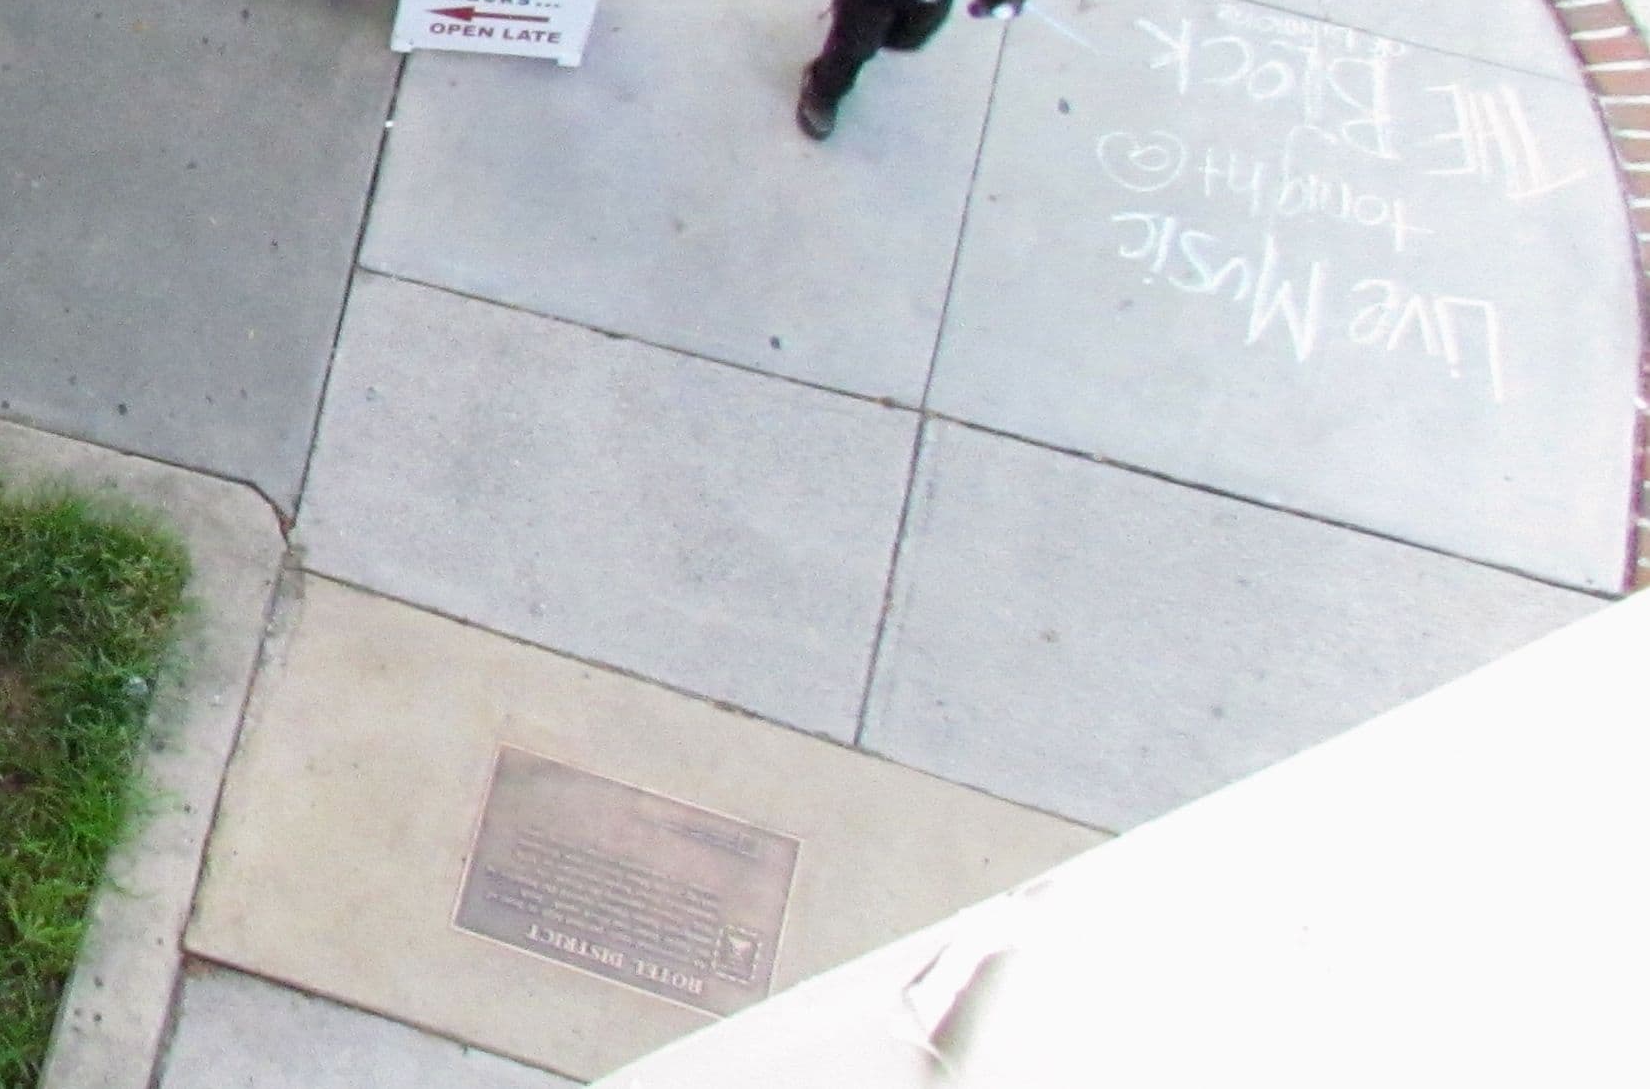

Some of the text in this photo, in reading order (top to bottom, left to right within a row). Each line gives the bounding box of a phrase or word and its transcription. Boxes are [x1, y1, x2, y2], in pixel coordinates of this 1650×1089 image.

[429, 22, 563, 44] OPEN LATE
[525, 923, 626, 970] DISTRICT
